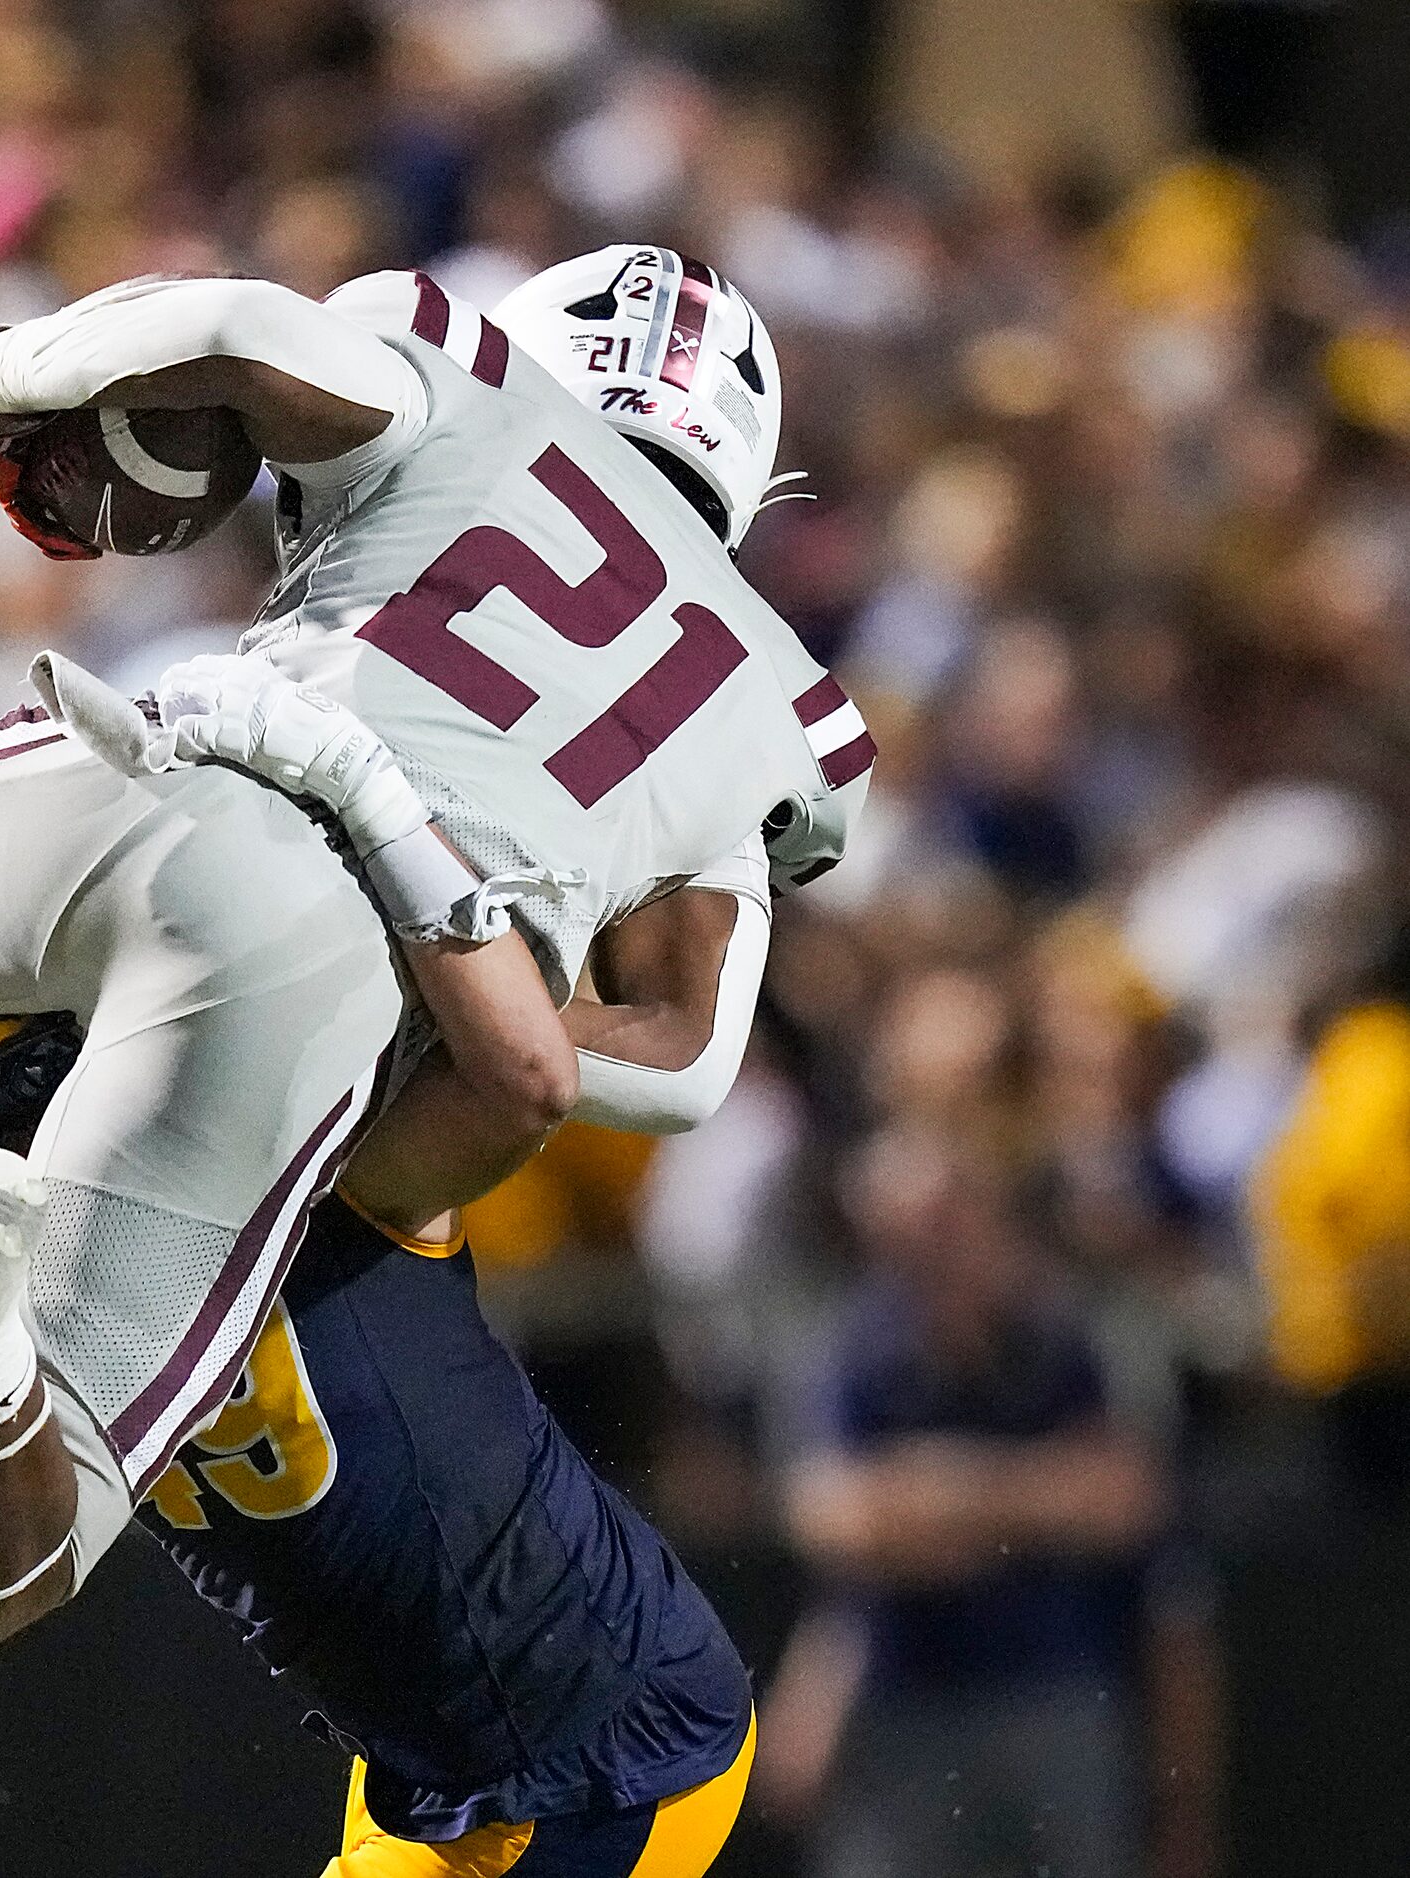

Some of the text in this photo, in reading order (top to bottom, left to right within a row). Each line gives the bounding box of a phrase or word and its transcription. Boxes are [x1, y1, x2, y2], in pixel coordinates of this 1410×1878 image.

[627, 276, 654, 302] 2
[588, 335, 631, 373] 21
[600, 387, 658, 415] The
[670, 406, 721, 452] Lew
[354, 442, 749, 810] 21
